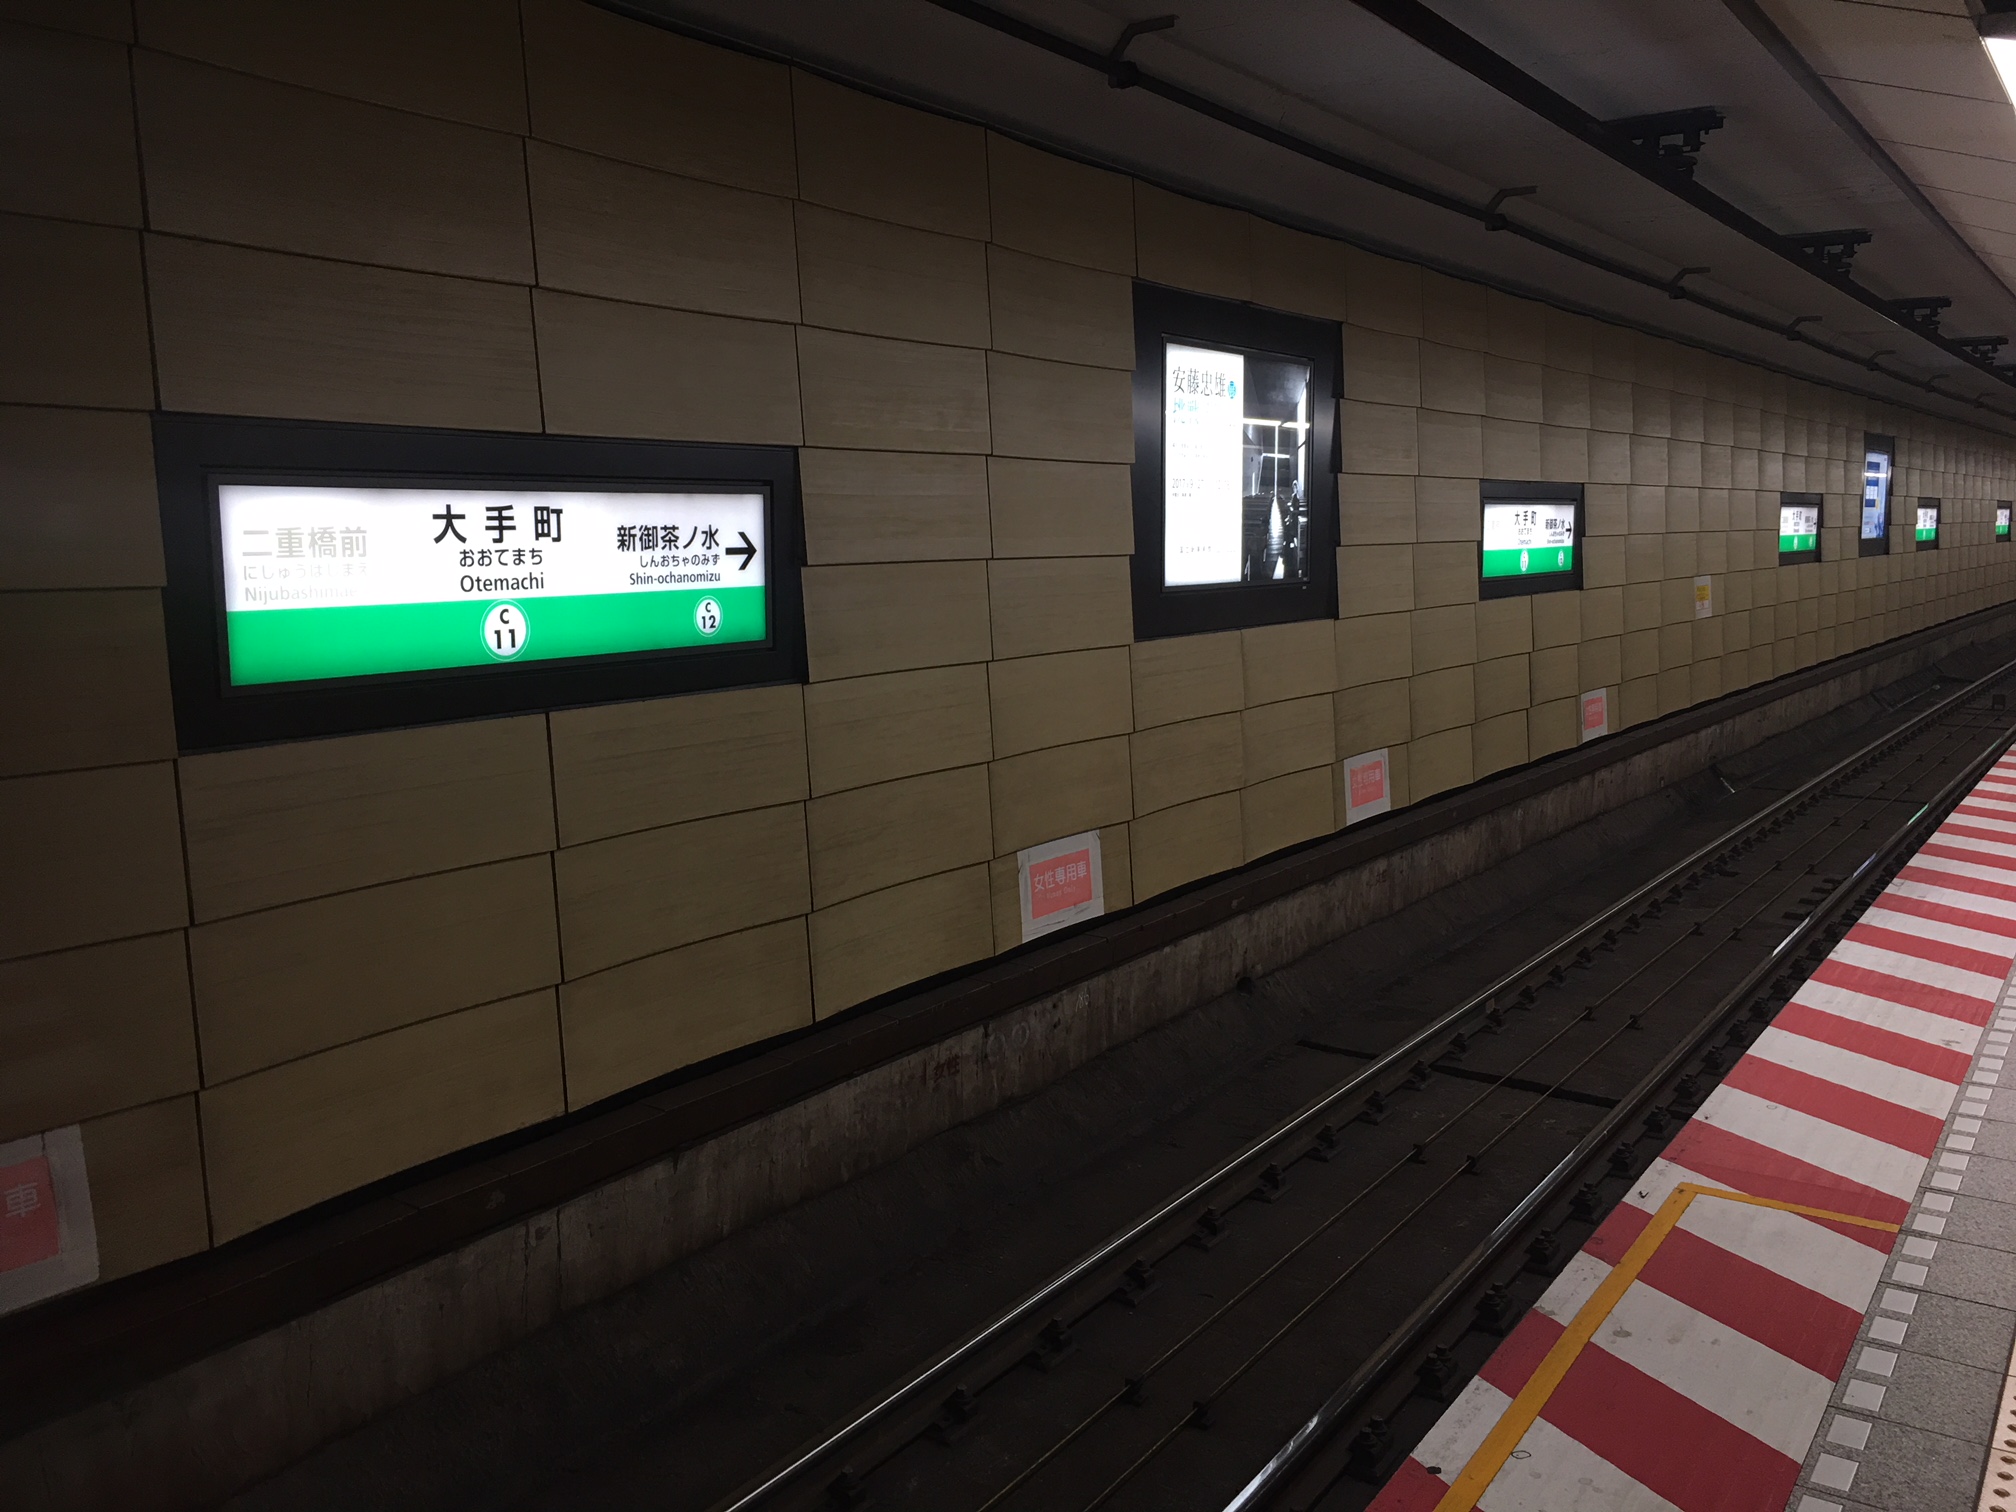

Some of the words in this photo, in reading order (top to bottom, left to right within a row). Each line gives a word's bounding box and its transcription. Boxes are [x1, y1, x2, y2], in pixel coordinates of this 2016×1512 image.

[1172, 366, 1226, 398] 安藤忠雄
[431, 503, 563, 545] 大手町
[1514, 510, 1537, 526] 大手町
[242, 526, 368, 559] 二重橋前
[617, 524, 720, 552] 新御茶ノ水
[459, 547, 543, 568] おおてまち
[640, 553, 721, 569] しんおちゃのみず
[460, 572, 544, 593] Otemachi
[629, 570, 721, 586] Shin-ochanomizu
[244, 585, 358, 606] Nijubashimae
[499, 608, 510, 625] C
[704, 602, 712, 614] C
[701, 615, 717, 629] 12
[494, 628, 517, 650] 11
[1033, 860, 1087, 893] 女性専用車
[4, 1183, 41, 1218] 車
